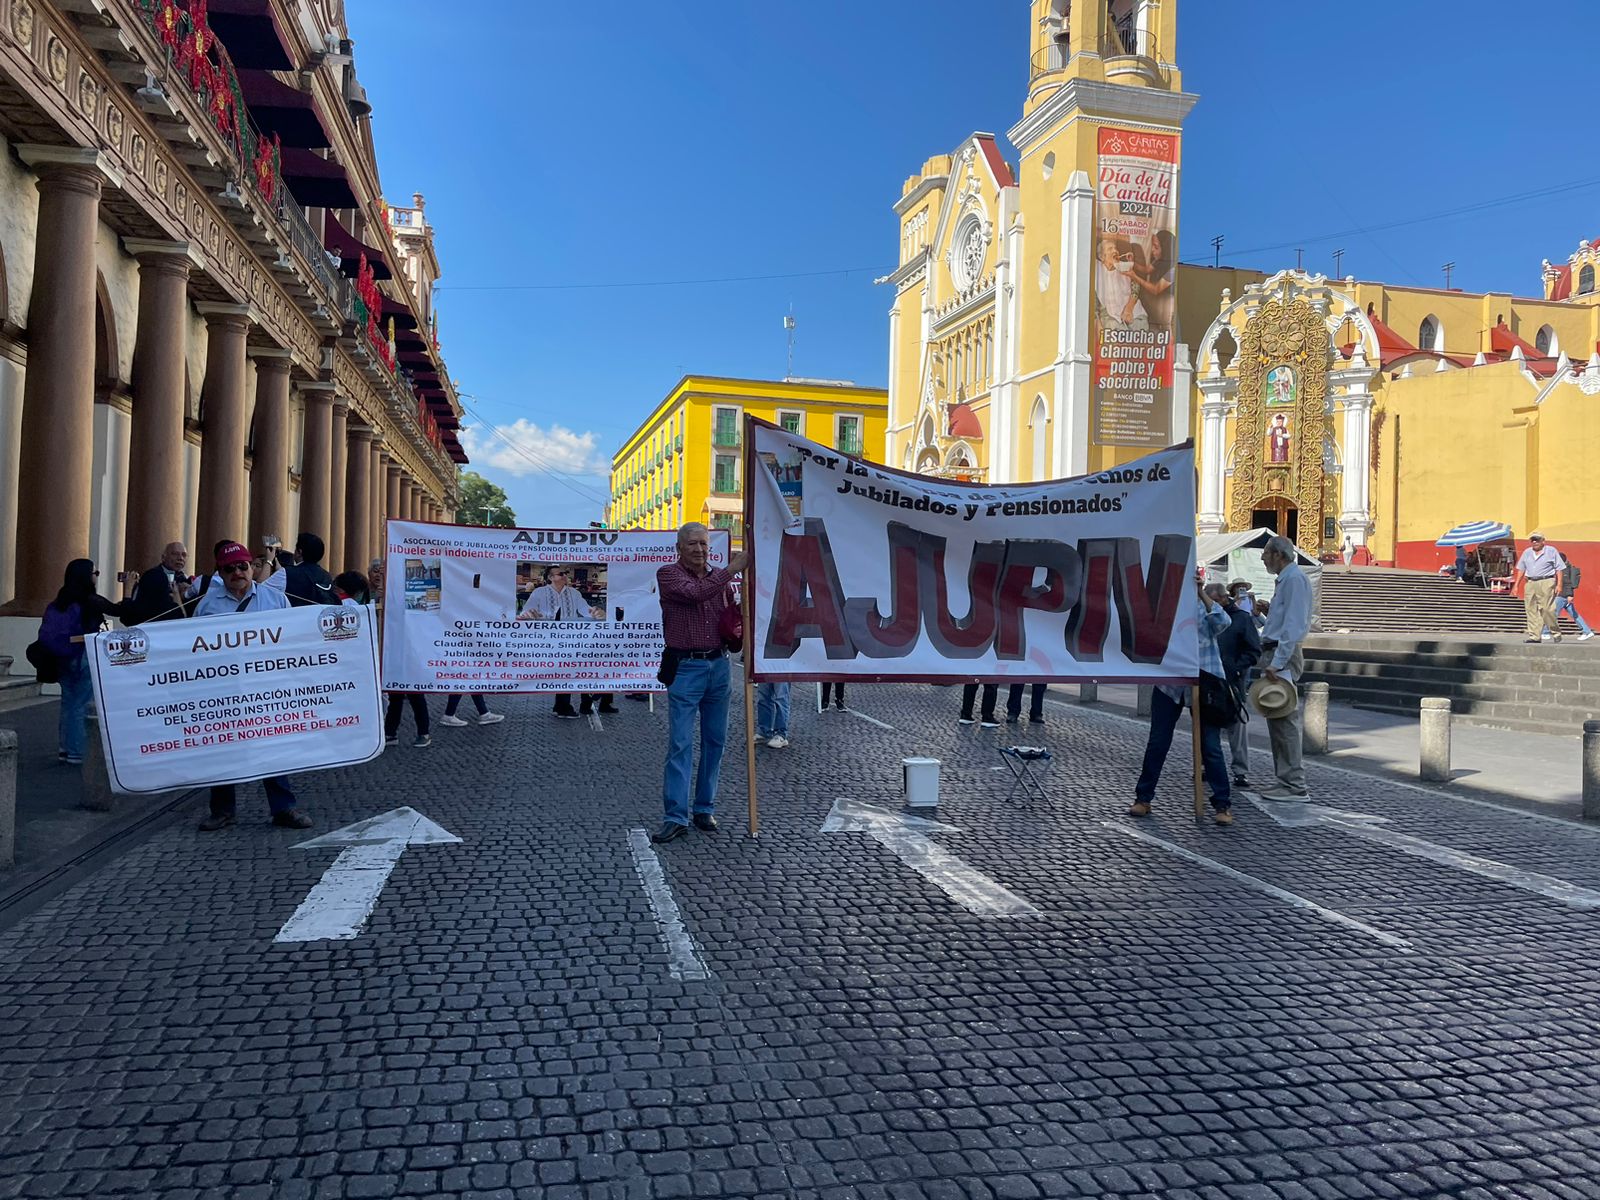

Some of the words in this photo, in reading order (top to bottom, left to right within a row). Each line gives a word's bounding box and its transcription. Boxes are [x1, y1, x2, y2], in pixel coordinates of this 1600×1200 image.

[1100, 167, 1130, 183] Día
[1135, 171, 1154, 186] de
[1158, 174, 1171, 190] la
[1103, 184, 1170, 204] Caridad
[1122, 203, 1150, 218] 2024
[1102, 218, 1118, 233] 16
[1100, 330, 1154, 344] ¡Escucha
[1158, 331, 1168, 344] el
[1100, 344, 1145, 358] clamor
[1147, 346, 1166, 359] del
[1110, 360, 1145, 376] pobre
[1148, 362, 1154, 376] y
[1099, 374, 1162, 390] socórrelo!
[845, 460, 868, 478] la
[1147, 463, 1170, 482] de
[837, 478, 958, 516] Jubilados
[963, 504, 979, 522] y
[403, 537, 452, 546] ASOCIACION
[466, 541, 510, 550] JUBILADOS
[512, 531, 619, 546] AJUPIV
[430, 548, 442, 556] su
[498, 550, 518, 560] risa
[520, 552, 536, 560] Sr.
[539, 550, 593, 561] Cuitláhuac
[764, 517, 1193, 665] AJUPIV
[454, 620, 481, 630] QUE
[485, 621, 520, 630] TODO
[525, 622, 592, 630] VERACRUZ
[595, 622, 610, 630] SE
[614, 622, 662, 630] ENTERE
[192, 626, 282, 653] AJUPIV
[434, 640, 473, 648] Claudia
[505, 642, 554, 650] Espinoza,
[444, 650, 494, 658] Jubilados
[148, 664, 240, 686] JUBILADOS
[244, 652, 338, 674] FEDERALES
[451, 660, 492, 668] POLIZA
[516, 672, 572, 680] noviembre
[414, 682, 434, 690] qué
[469, 682, 520, 690] contrató?
[536, 682, 574, 690] ¿Dónde
[578, 682, 605, 690] están
[137, 702, 196, 718] EXIGIMOS
[199, 688, 291, 709] CONTRATACIÓN
[295, 682, 356, 696] INMEDIATA
[164, 716, 188, 726] DEL
[190, 708, 241, 722] SEGURO
[244, 696, 333, 714] INSTITUCIONAL
[184, 726, 200, 735] NO
[204, 716, 270, 732] CONTAMOS
[274, 712, 300, 723] CON
[303, 710, 318, 719] EL
[140, 740, 180, 754] DESDE
[184, 738, 200, 748] EL
[202, 736, 214, 745] 01
[218, 733, 234, 742] DE
[238, 722, 307, 739] NOVIEMBRE
[311, 720, 333, 730] DEL
[336, 716, 360, 726] 2021
